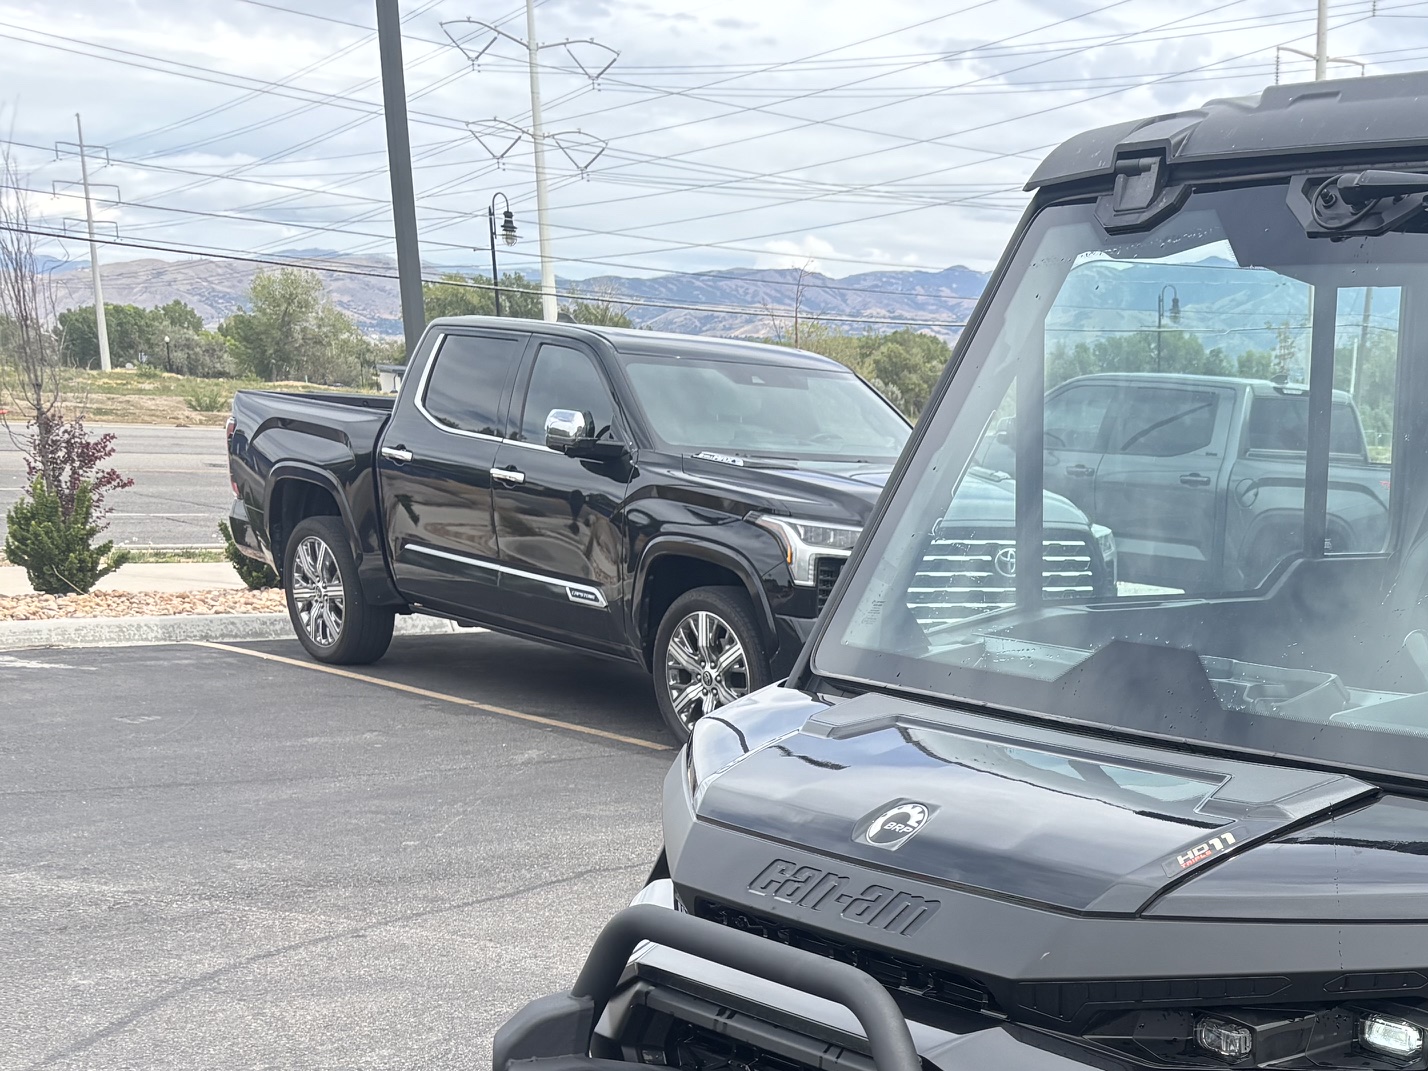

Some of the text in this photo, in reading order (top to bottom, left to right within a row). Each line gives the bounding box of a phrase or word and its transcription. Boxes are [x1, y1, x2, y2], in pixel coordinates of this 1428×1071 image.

[884, 822, 914, 833] BRP
[1177, 832, 1236, 865] HD11
[1181, 849, 1212, 868] TRIPLE
[747, 858, 941, 938] can-am
